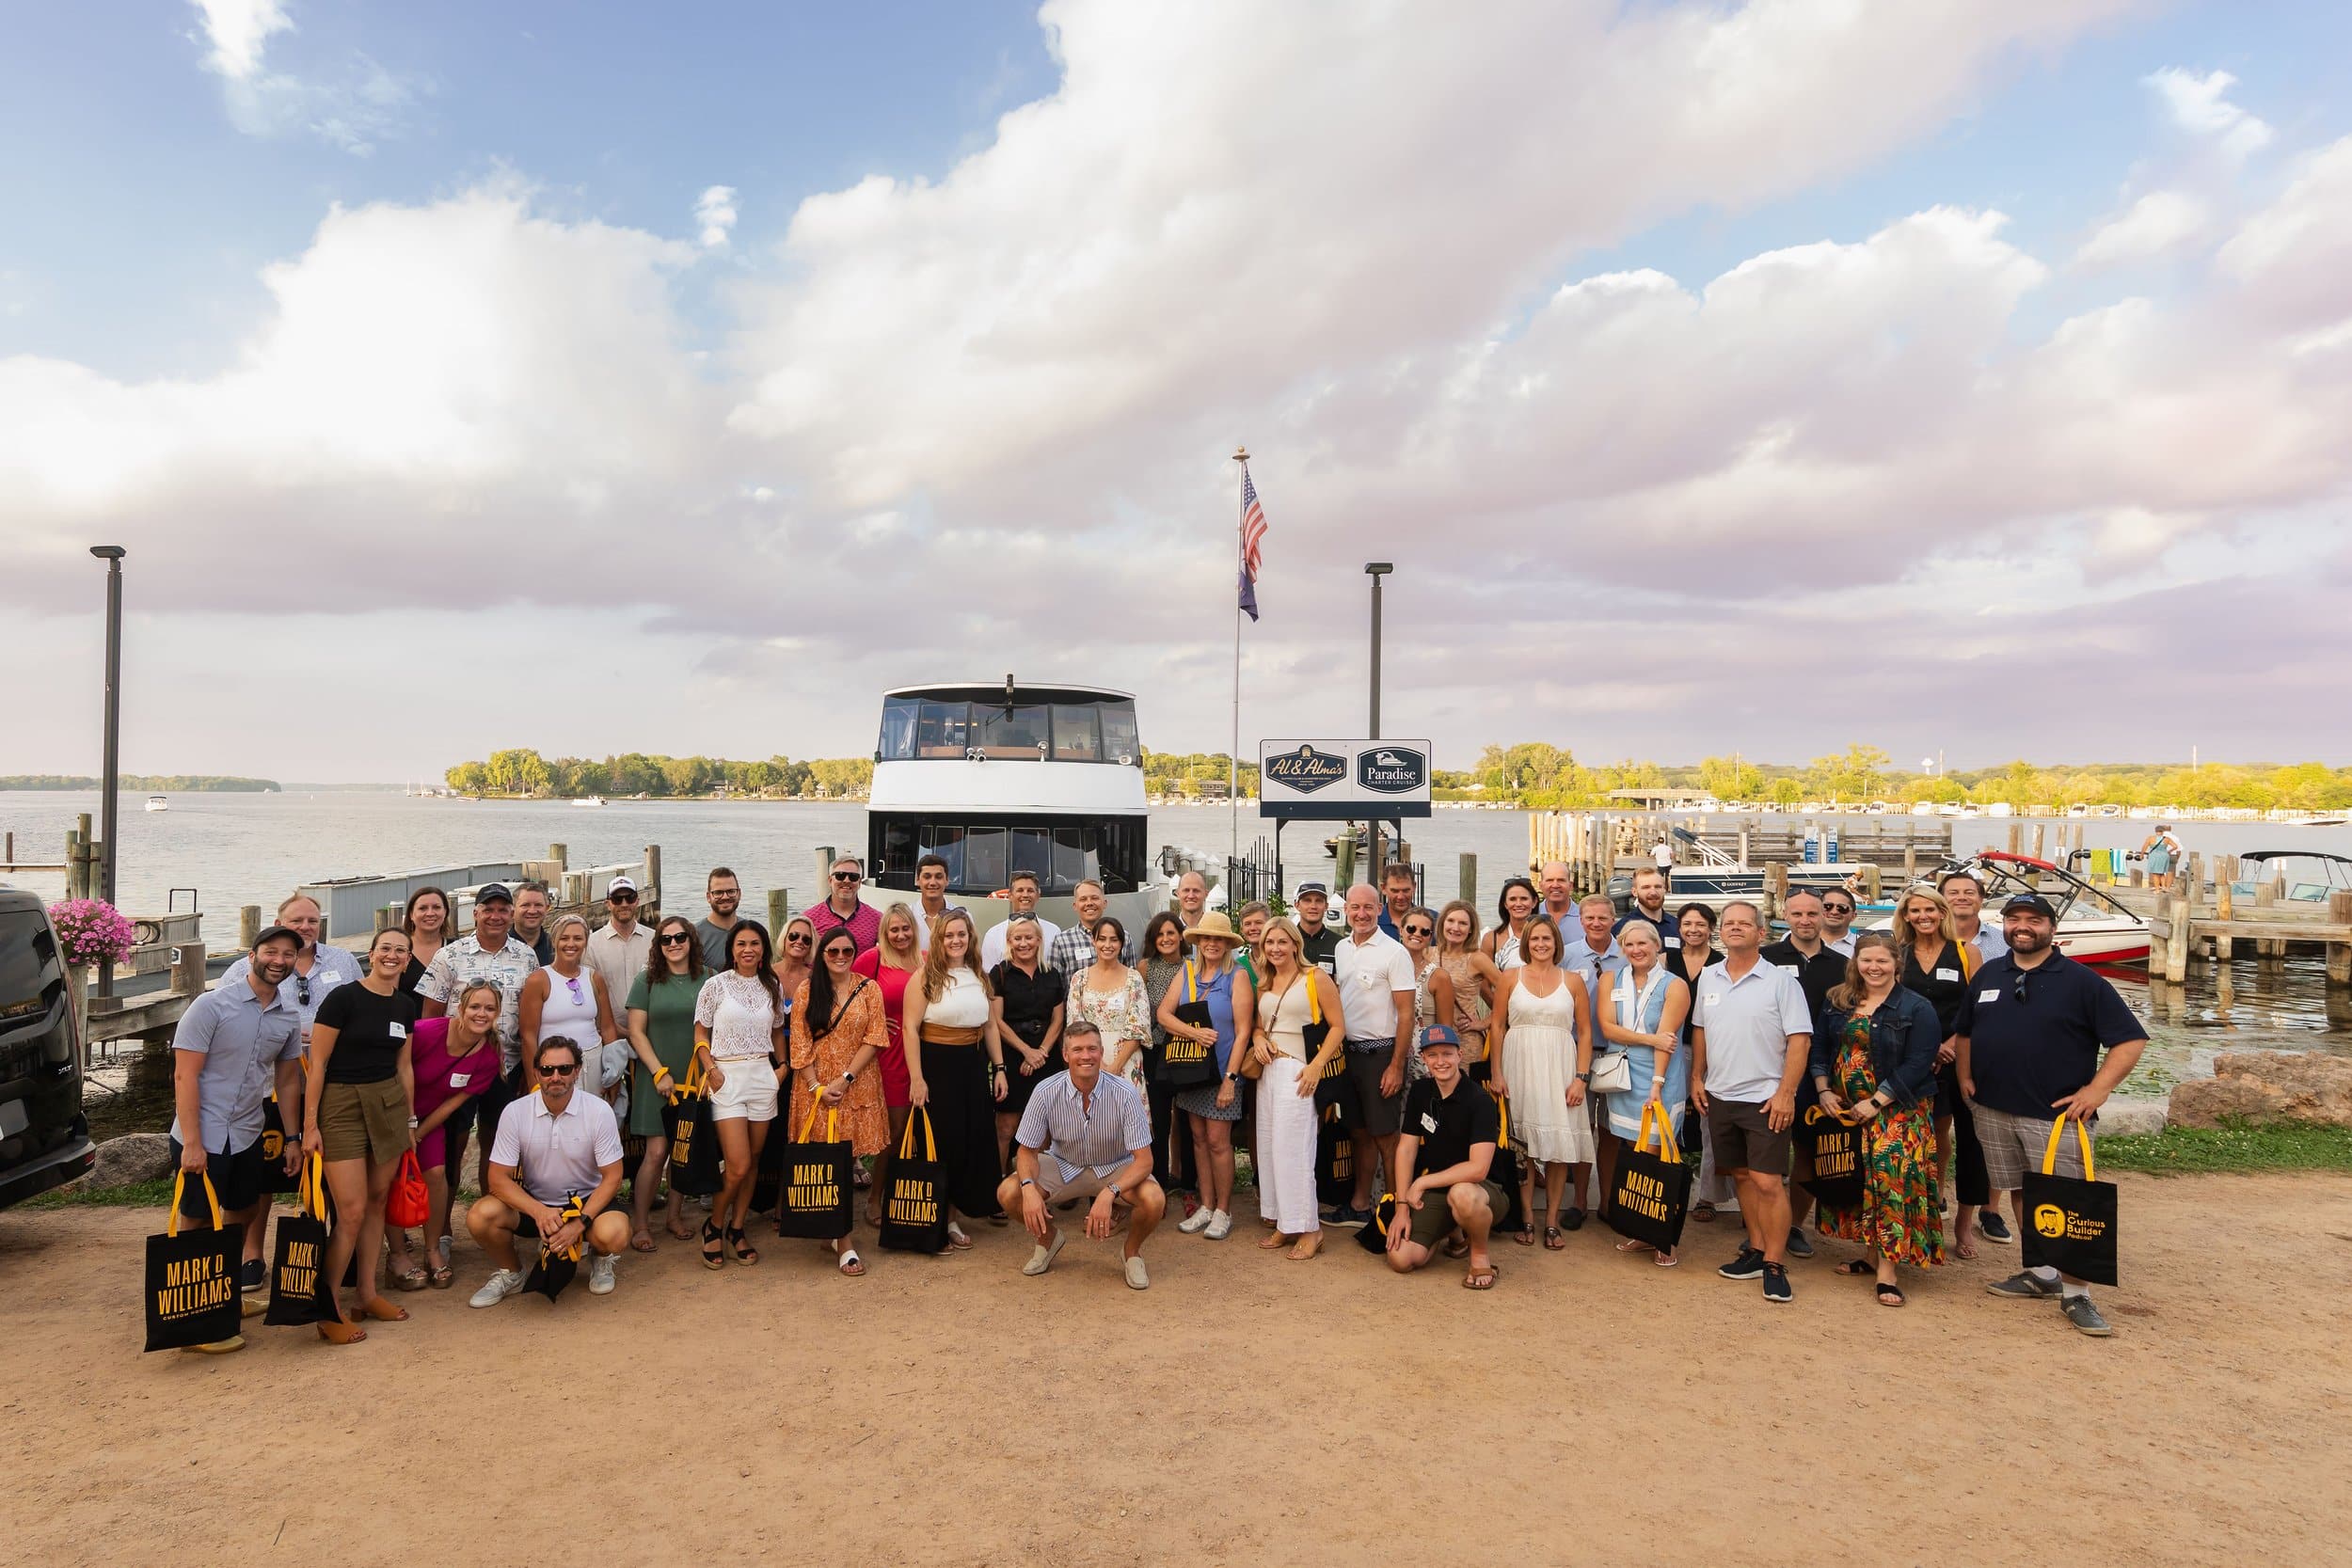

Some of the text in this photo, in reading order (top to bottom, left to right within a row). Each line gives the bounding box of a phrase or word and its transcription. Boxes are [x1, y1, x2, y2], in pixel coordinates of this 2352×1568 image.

[1270, 758, 1343, 775] Al & Alma's
[1367, 767, 1416, 780] Paradise
[1166, 1042, 1208, 1060] WILLIAMS
[793, 1164, 824, 1185] MARK
[827, 1164, 834, 1184] D
[1815, 1150, 1855, 1177] WILLIAMS
[787, 1185, 839, 1207] WILLIAMS
[895, 1179, 932, 1201] MARK D
[1626, 1170, 1663, 1202] MARK D
[889, 1198, 938, 1223] WILLIAMS
[2067, 1216, 2106, 1228] Curious
[2067, 1224, 2102, 1236] Builder
[2067, 1232, 2092, 1241] Podcast
[287, 1241, 314, 1268] MARK
[167, 1254, 224, 1288] MARK D
[158, 1276, 231, 1315] WILLIAMS
